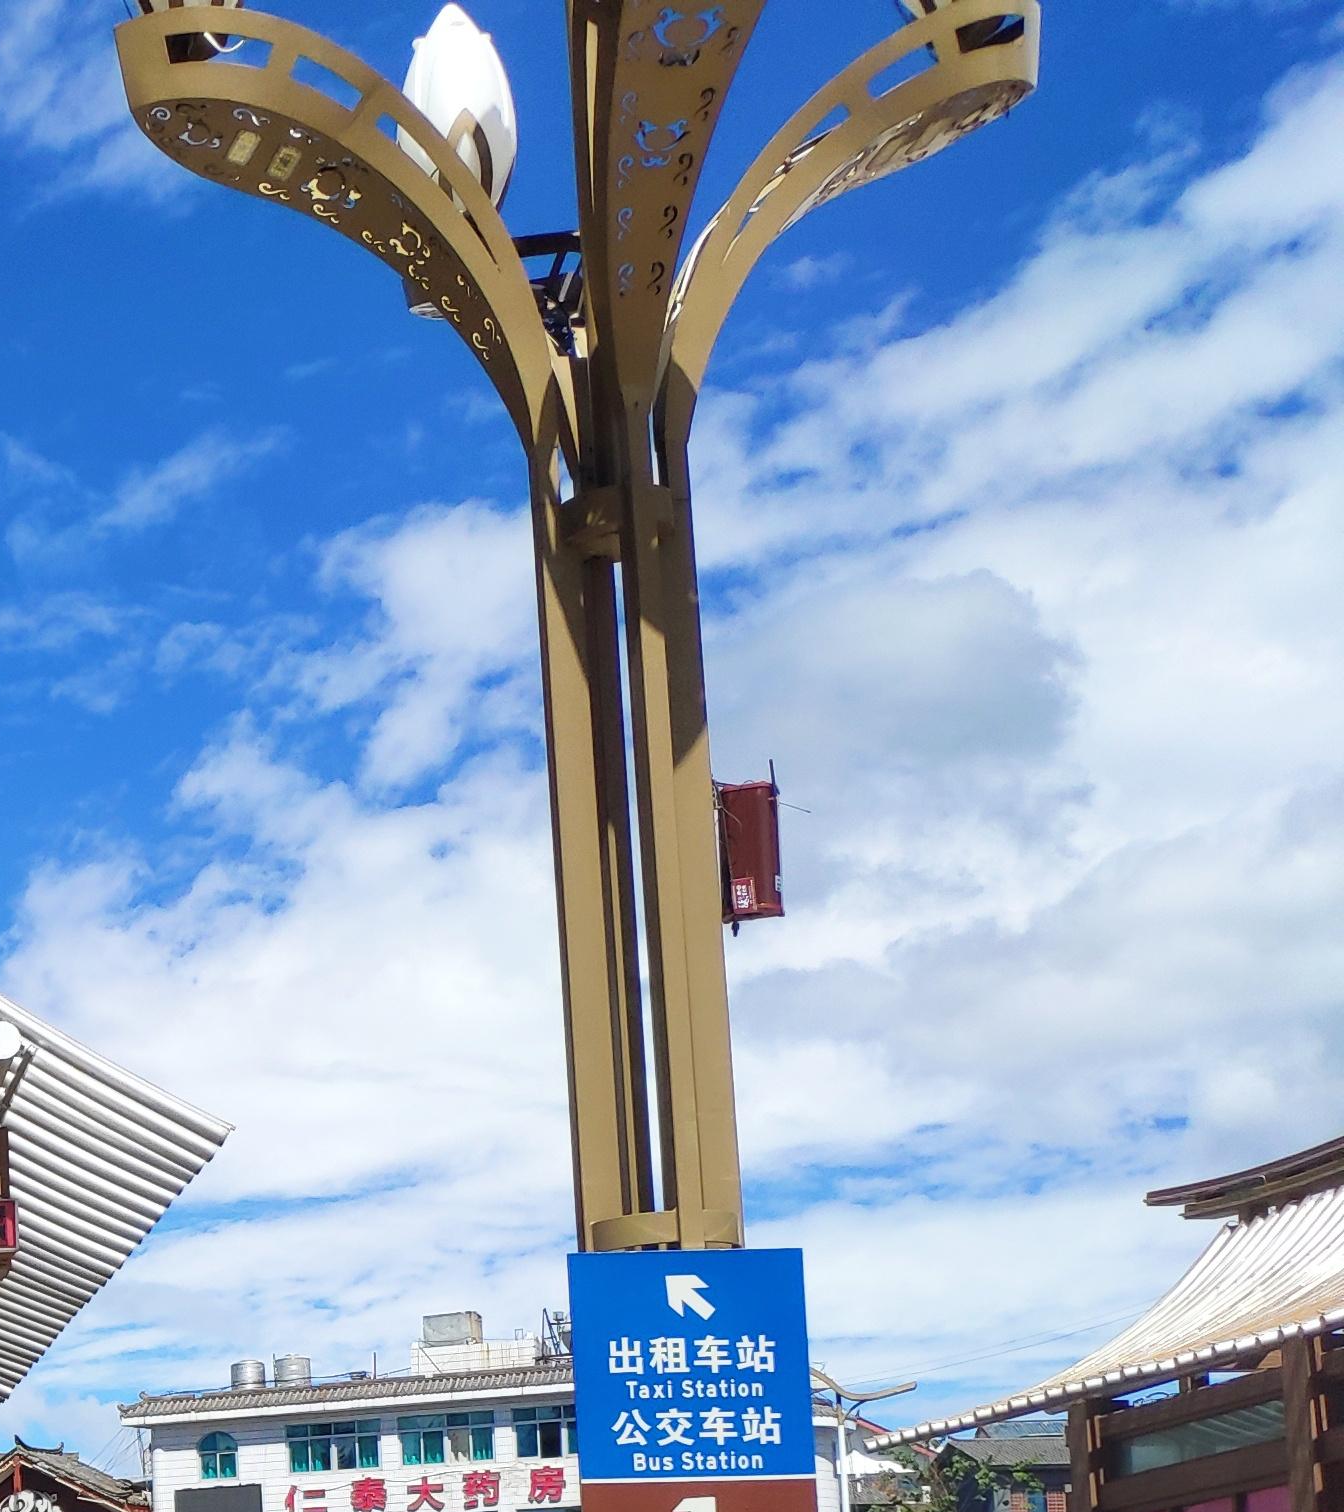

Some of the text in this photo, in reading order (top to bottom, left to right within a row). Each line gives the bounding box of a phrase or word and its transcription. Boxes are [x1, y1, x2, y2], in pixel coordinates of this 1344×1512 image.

[608, 1335, 777, 1375] 出租车站
[625, 1378, 764, 1399] Taxi Station
[611, 1406, 782, 1446] 公交车站
[633, 1451, 764, 1472] Bus Station
